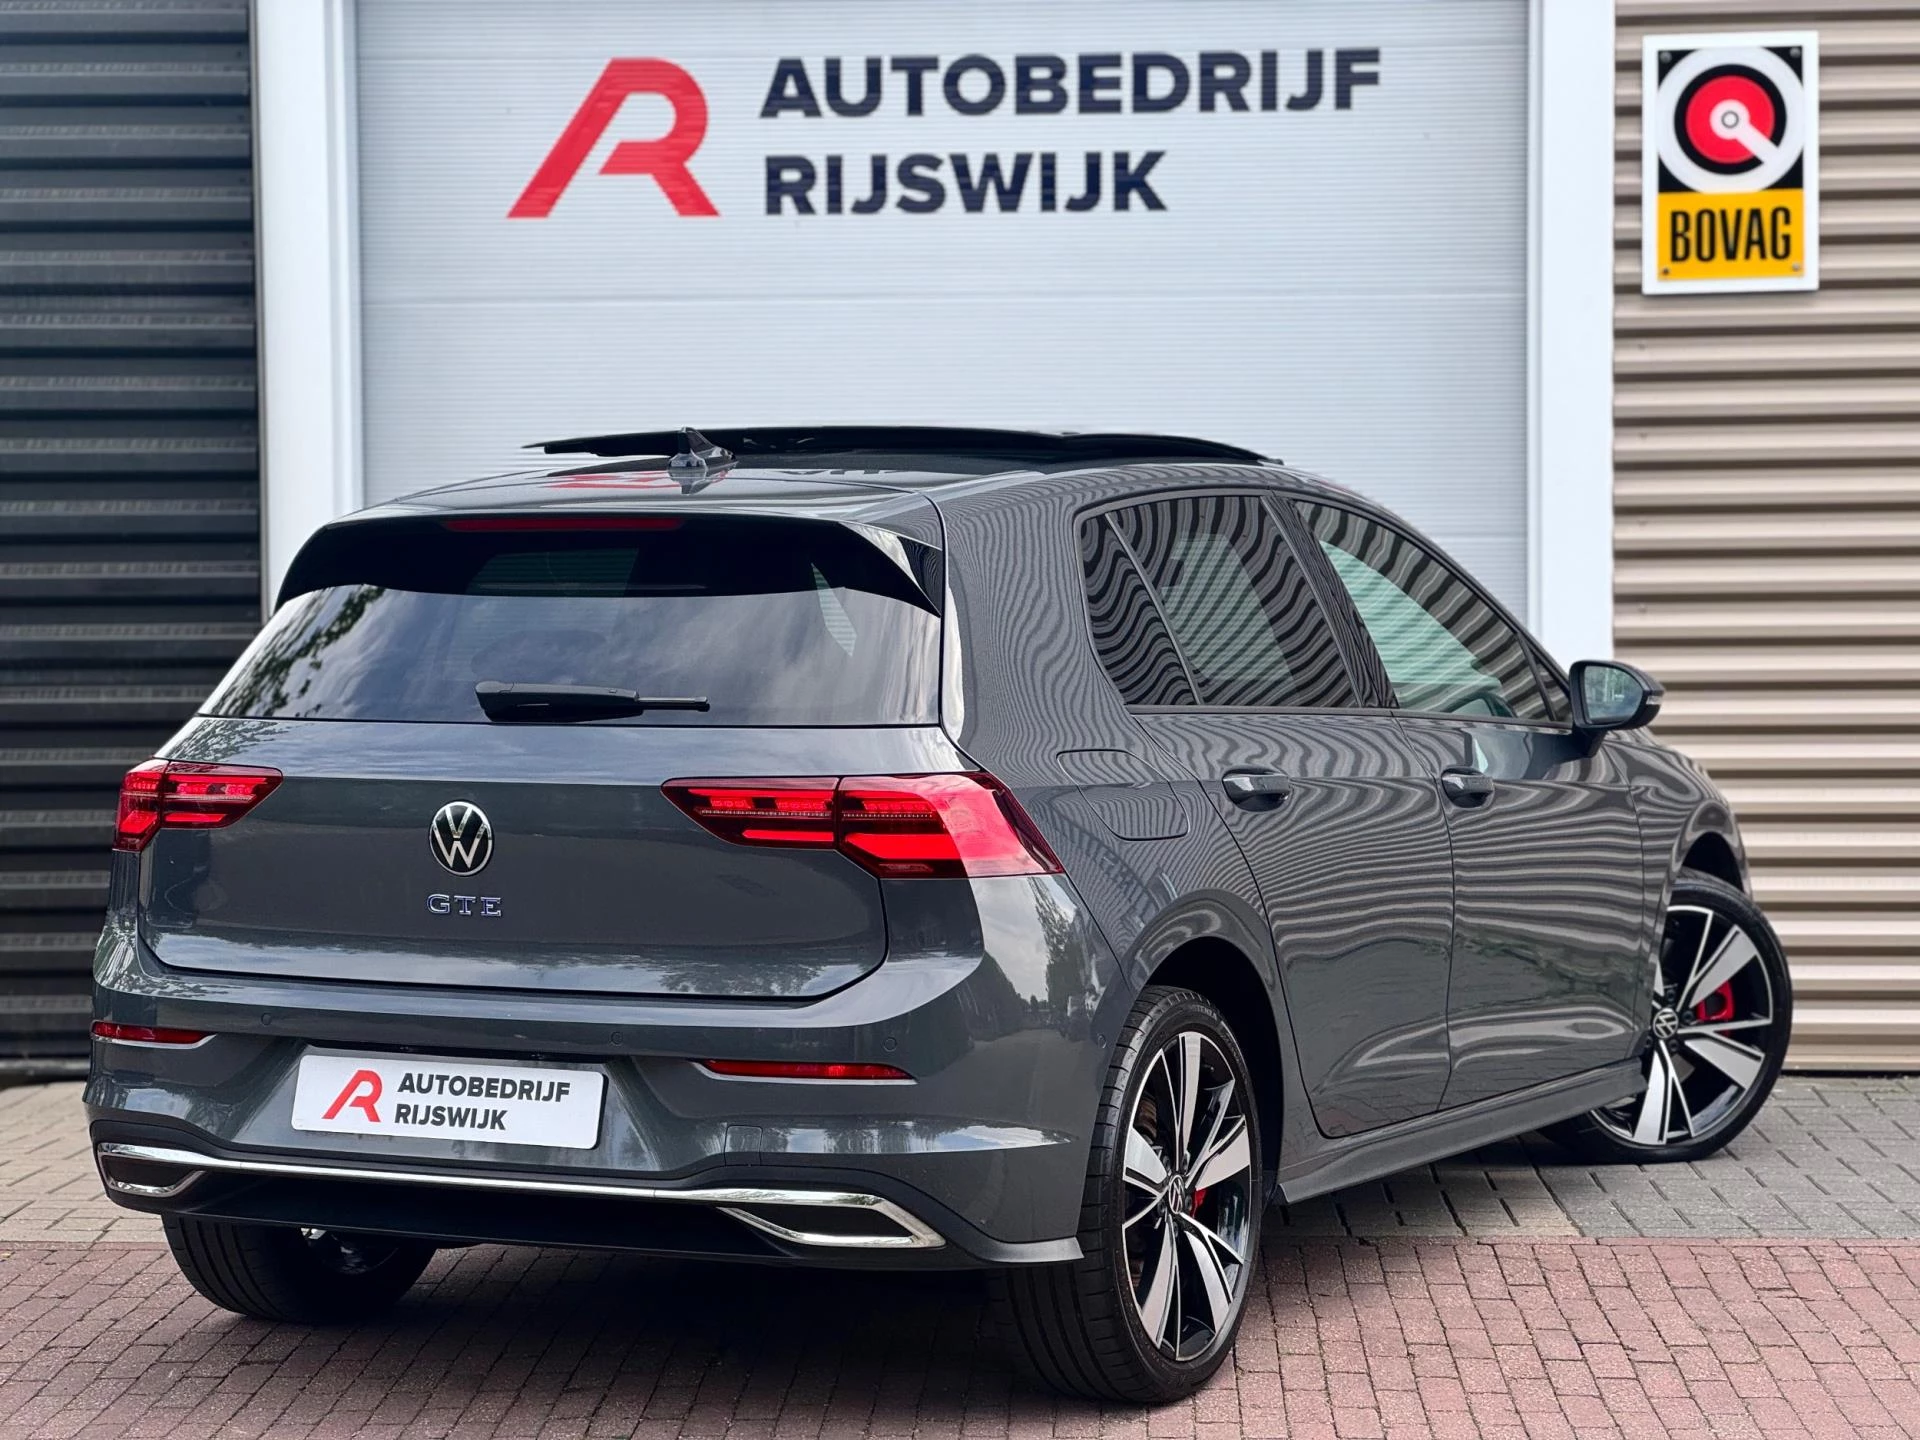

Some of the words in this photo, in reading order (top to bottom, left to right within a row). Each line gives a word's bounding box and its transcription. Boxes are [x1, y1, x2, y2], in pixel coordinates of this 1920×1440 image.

[760, 48, 1380, 118] AUTOBEDRIJF
[765, 151, 1168, 215] RIJSWIJK
[1670, 206, 1791, 263] BOVAG
[427, 893, 502, 917] GTE
[397, 1072, 571, 1103] AUTOBEDRIJF
[394, 1103, 507, 1131] RIJSWIJK
